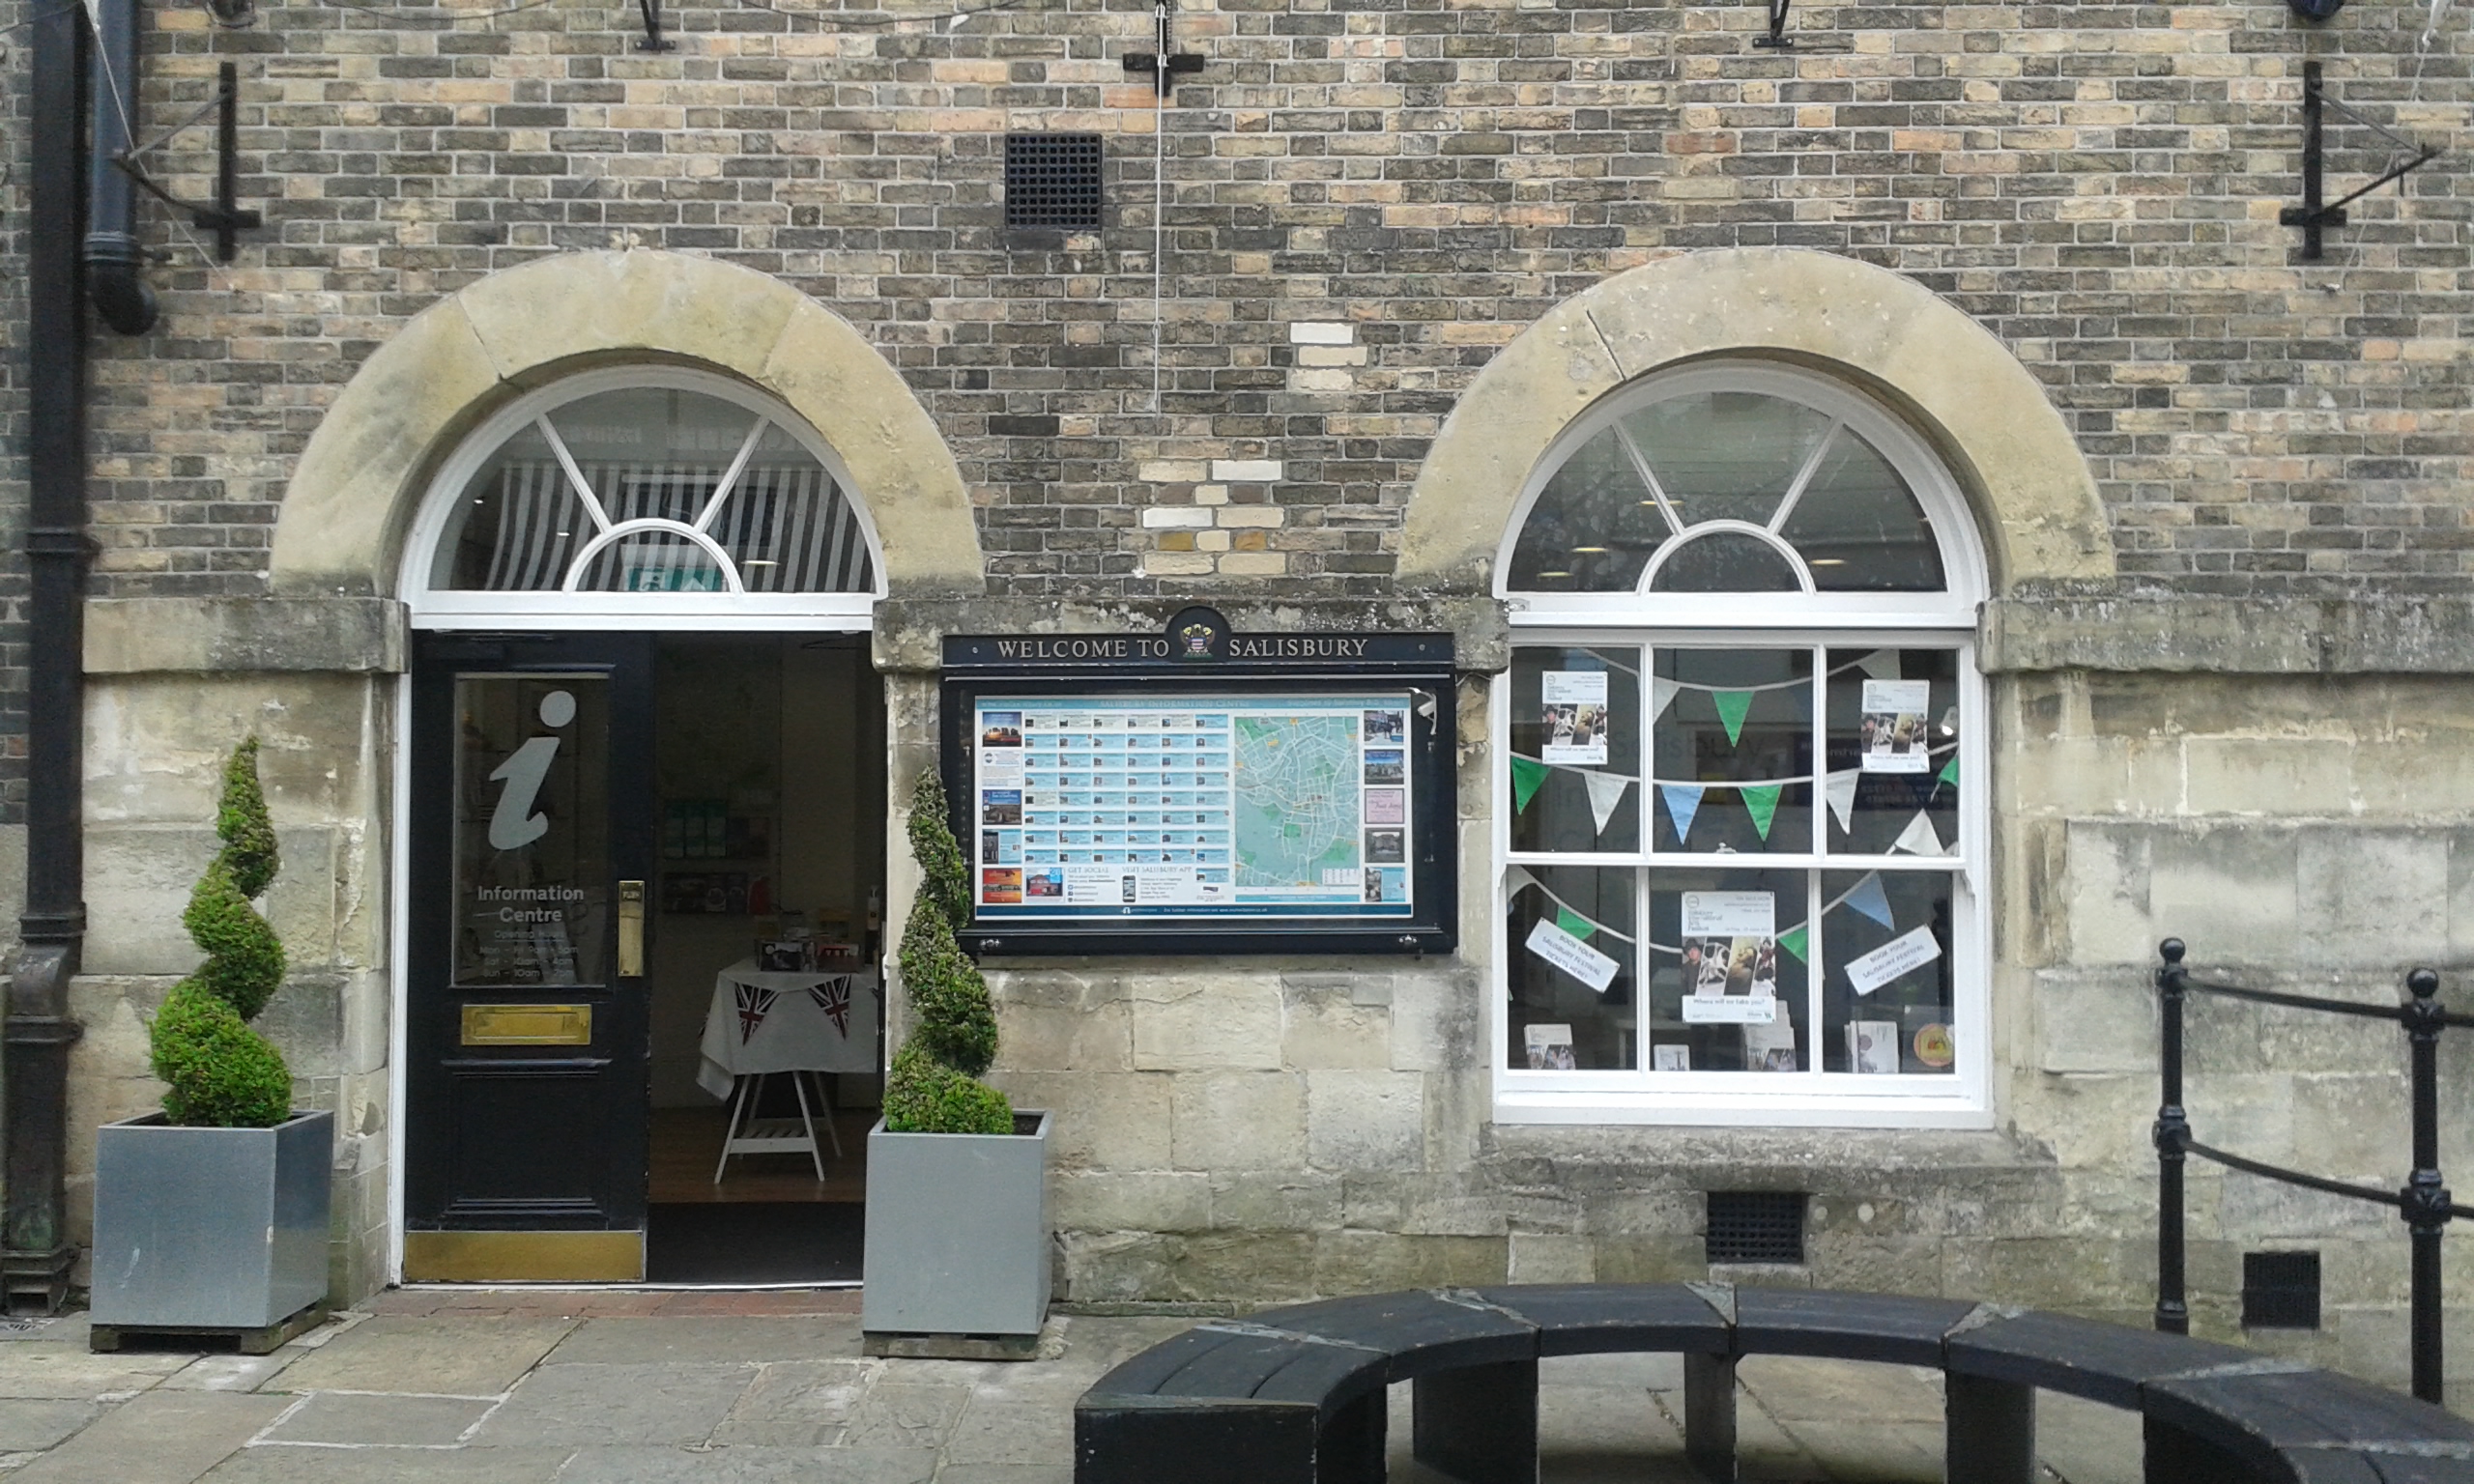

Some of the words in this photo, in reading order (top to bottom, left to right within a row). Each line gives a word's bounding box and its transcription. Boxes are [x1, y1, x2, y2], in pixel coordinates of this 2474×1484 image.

[997, 639, 1129, 659] WELCOME
[1136, 639, 1170, 658] TO
[1228, 639, 1368, 658] SALISBURY
[477, 884, 586, 901] Information
[499, 906, 563, 923] Centre
